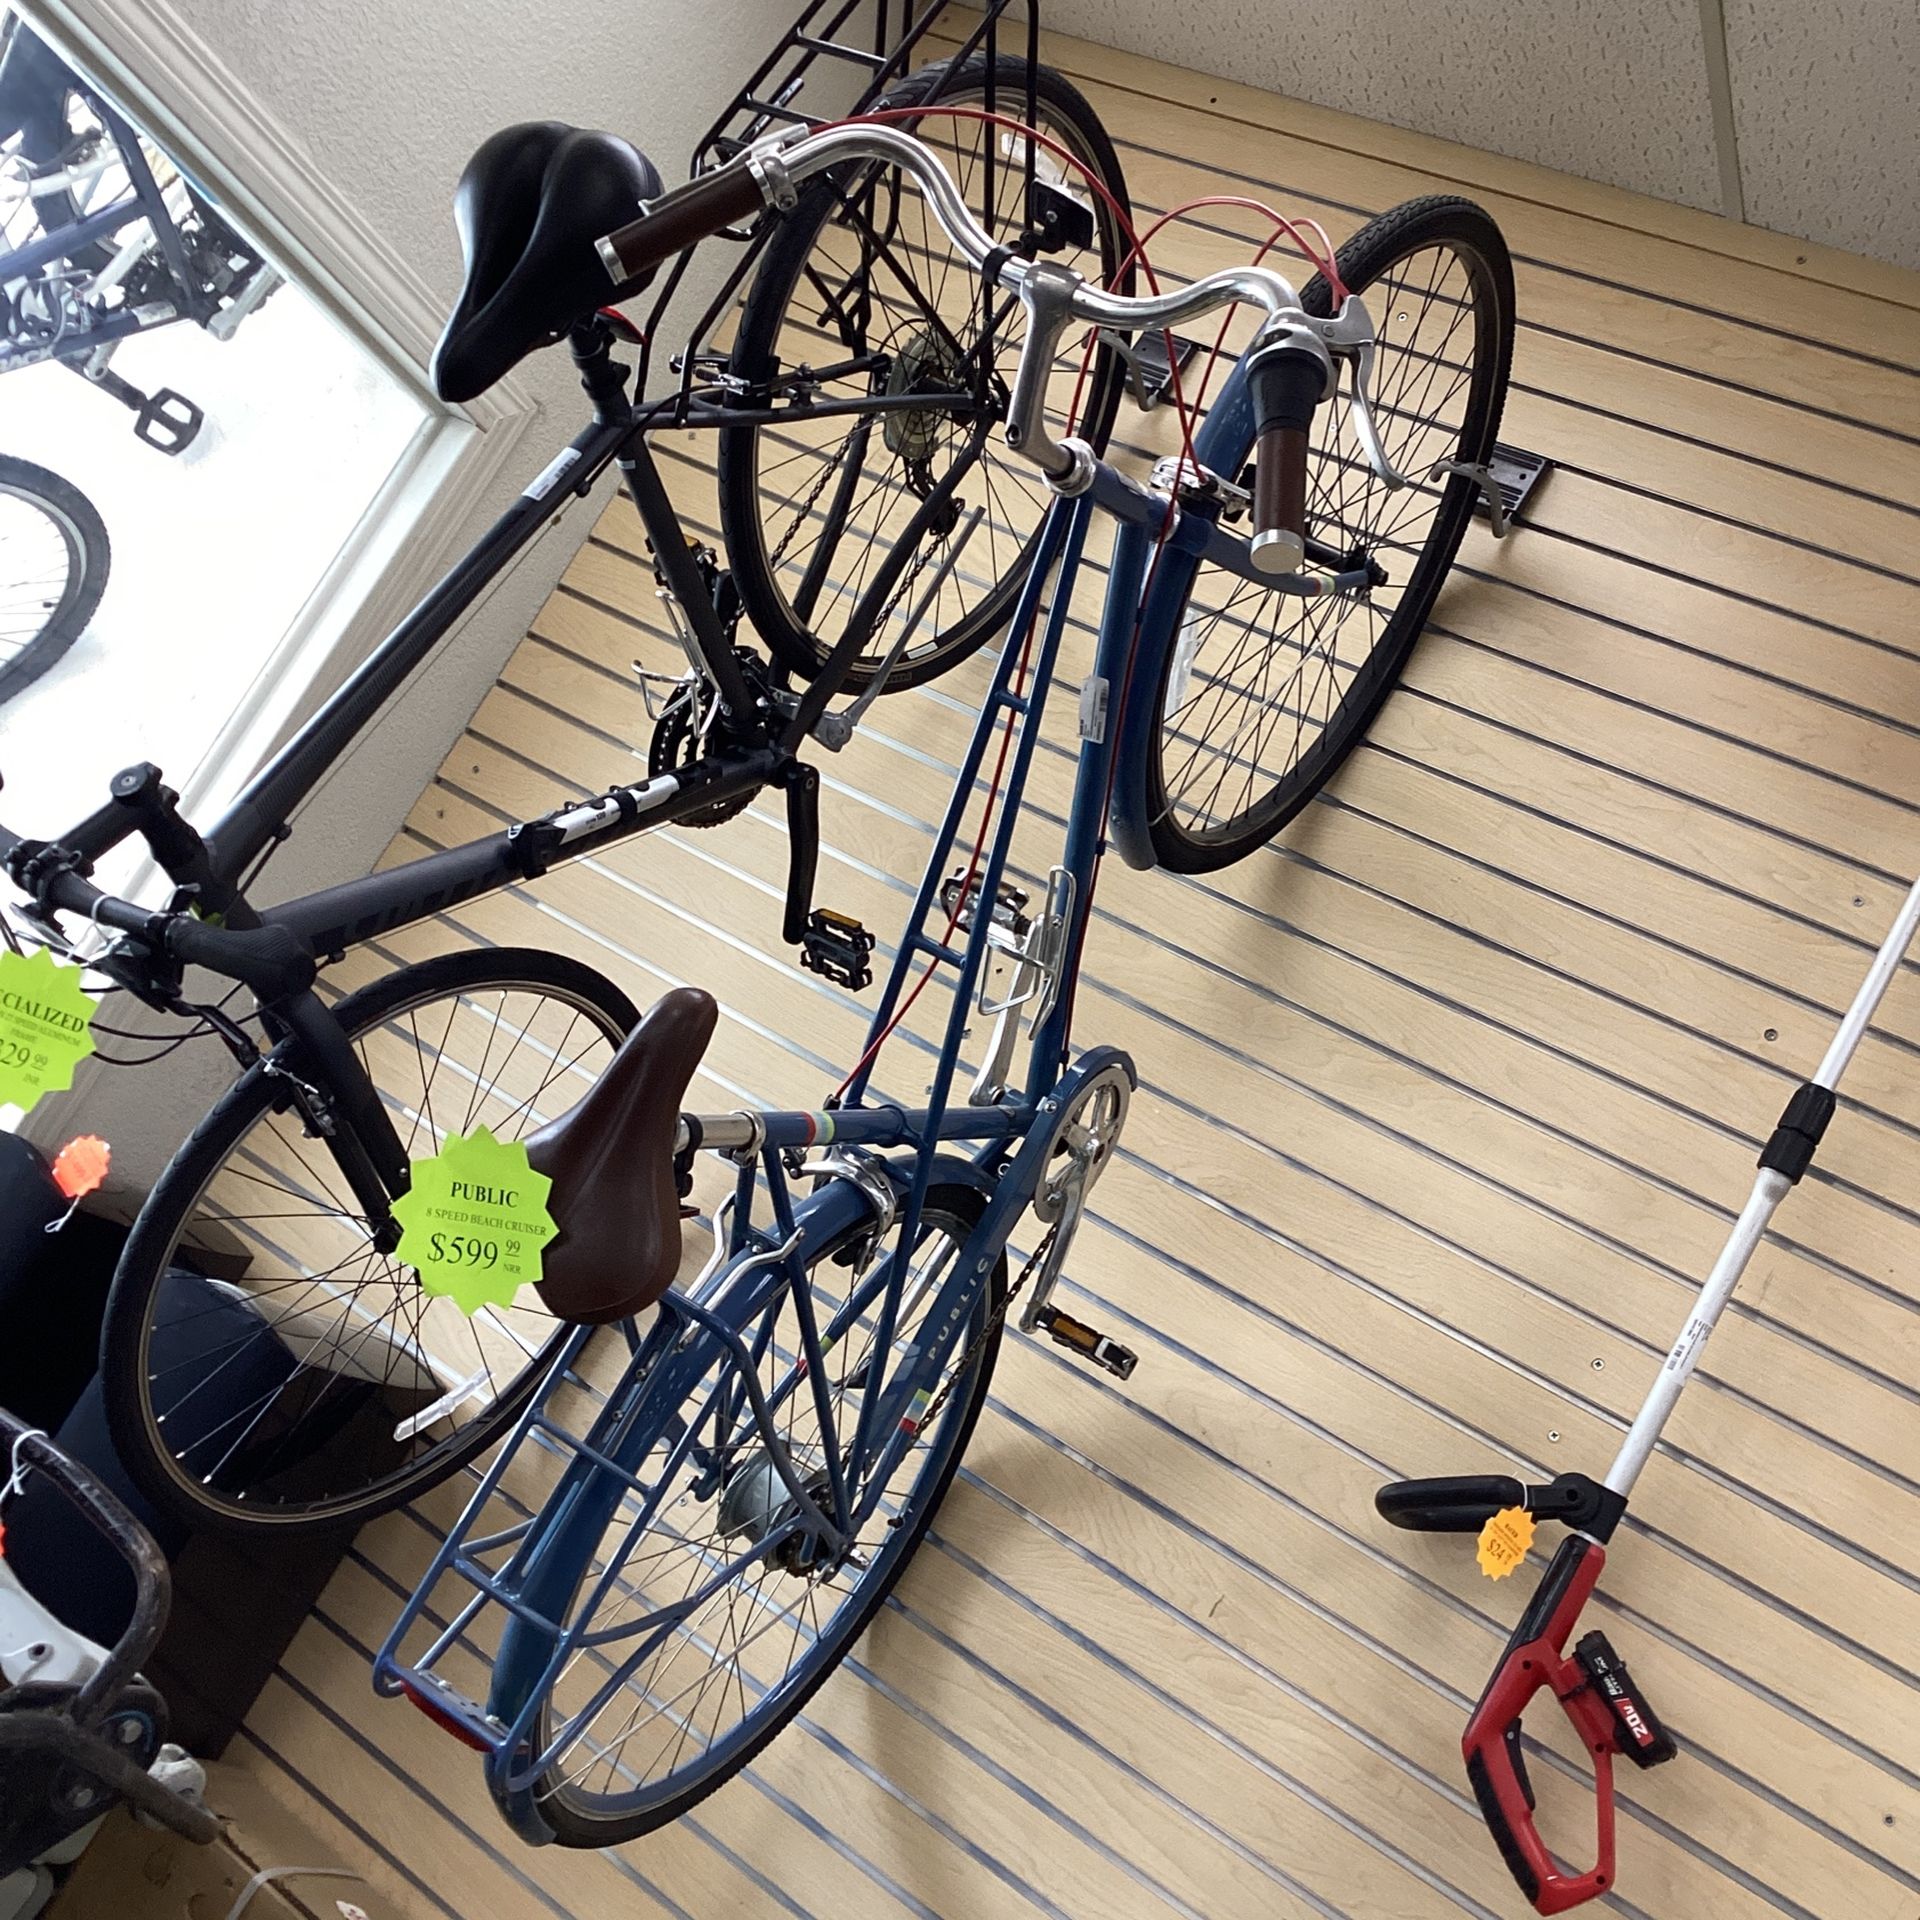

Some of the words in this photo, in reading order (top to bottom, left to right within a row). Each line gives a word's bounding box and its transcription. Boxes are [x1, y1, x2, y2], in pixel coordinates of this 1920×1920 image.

[0, 989, 84, 1033] CIALIZED
[0, 1038, 30, 1068] 29
[451, 1181, 519, 1208] PUBLIC
[426, 1207, 432, 1217] 8
[435, 1208, 469, 1223] SPEED
[470, 1214, 504, 1229] BEACH
[504, 1220, 547, 1236] CRUISER
[427, 1232, 499, 1269] $599
[505, 1239, 521, 1255] 99
[928, 1258, 988, 1360] PUBLIC
